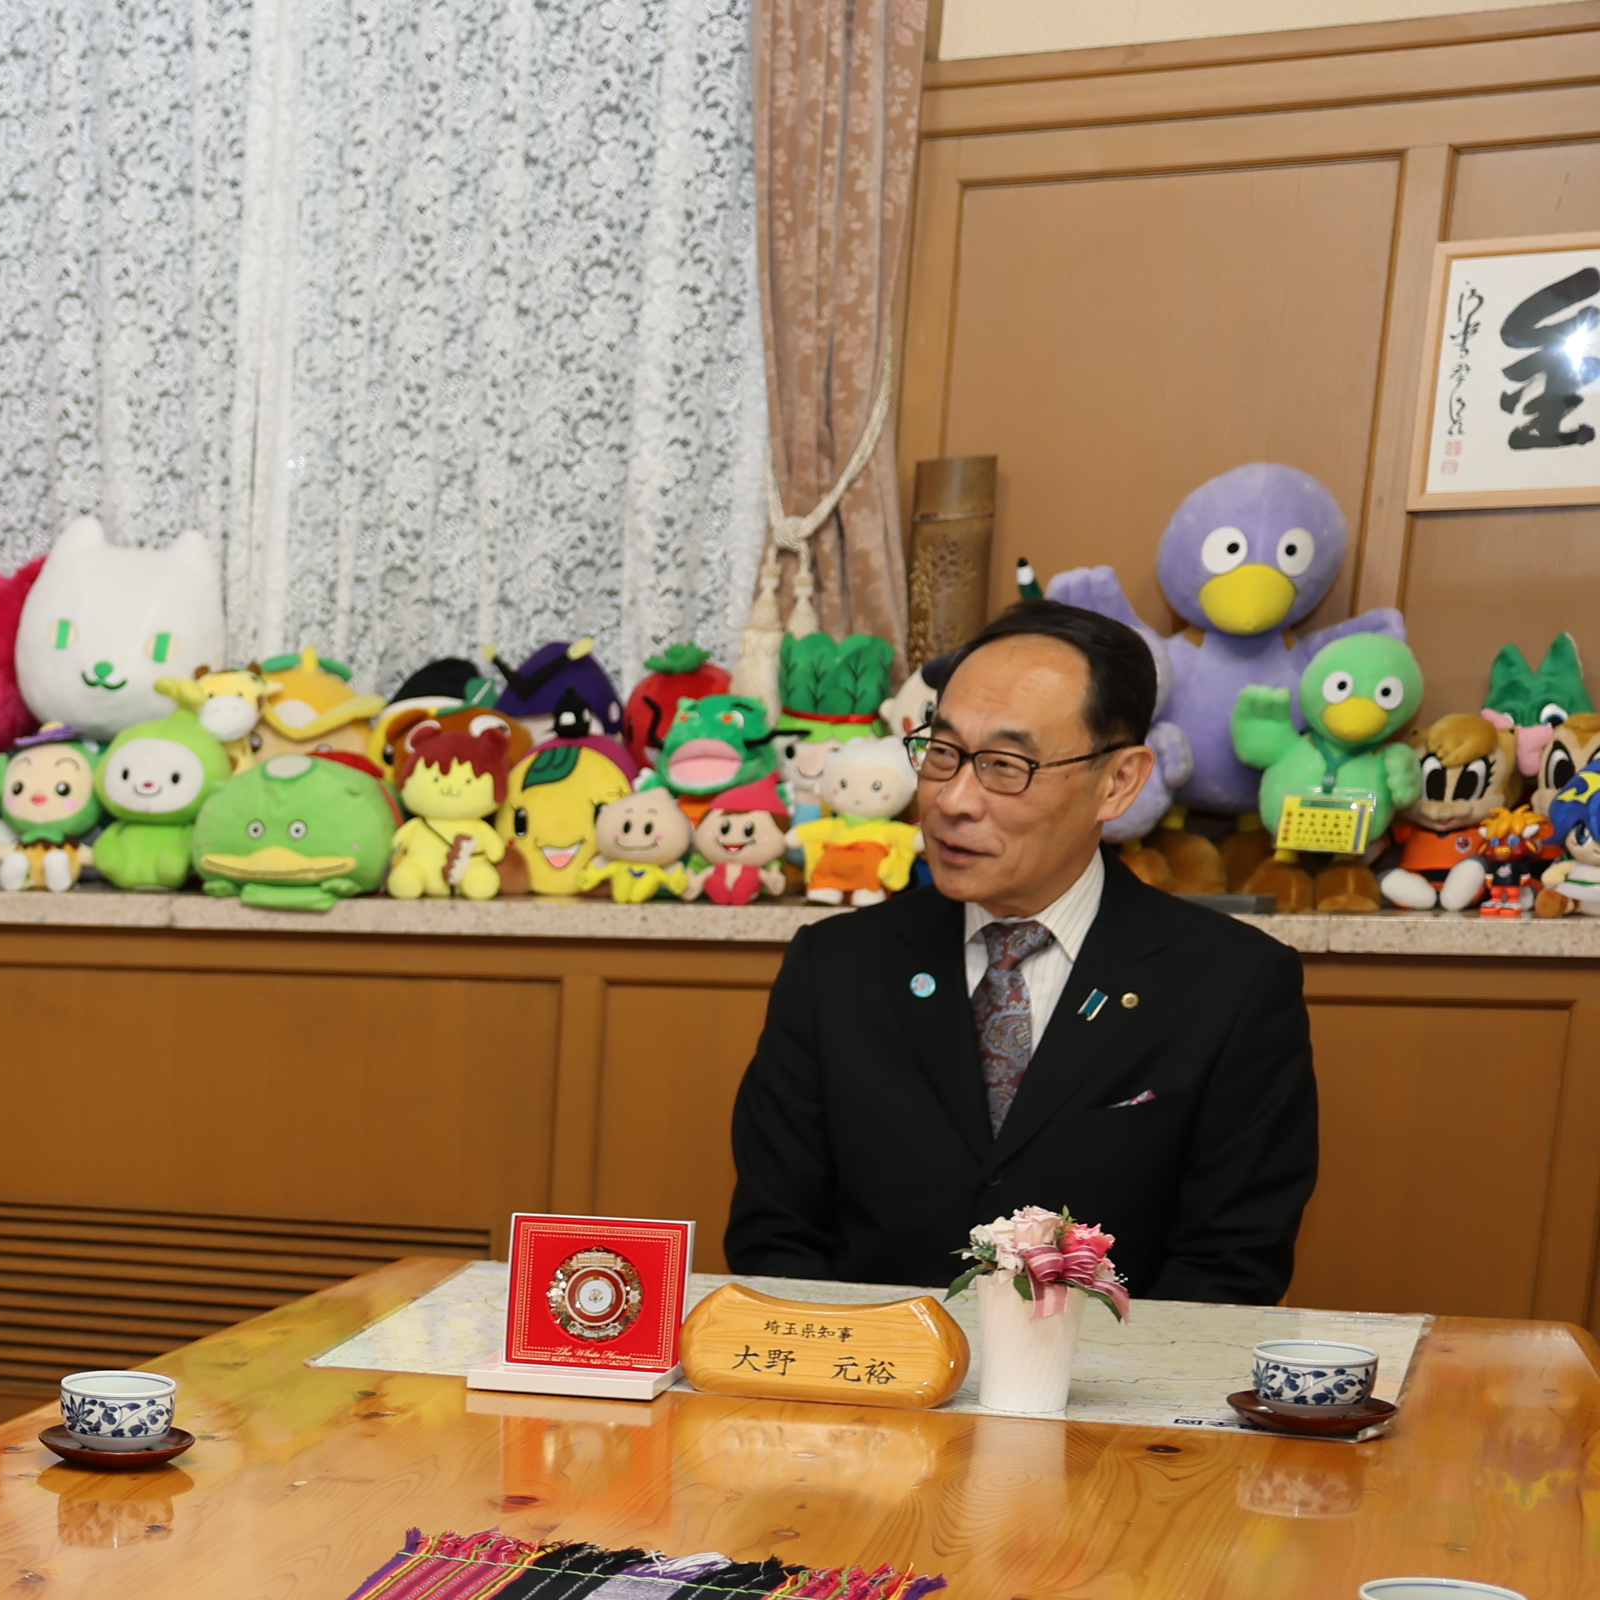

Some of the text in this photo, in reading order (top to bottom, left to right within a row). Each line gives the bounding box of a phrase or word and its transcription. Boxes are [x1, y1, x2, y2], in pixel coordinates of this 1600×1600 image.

[764, 1320, 854, 1343] 埼玉県知事
[551, 1356, 632, 1366] HISTORICAL ASSOCIATION
[554, 1344, 632, 1360] The White House
[732, 1345, 897, 1385] 大野 元裕
